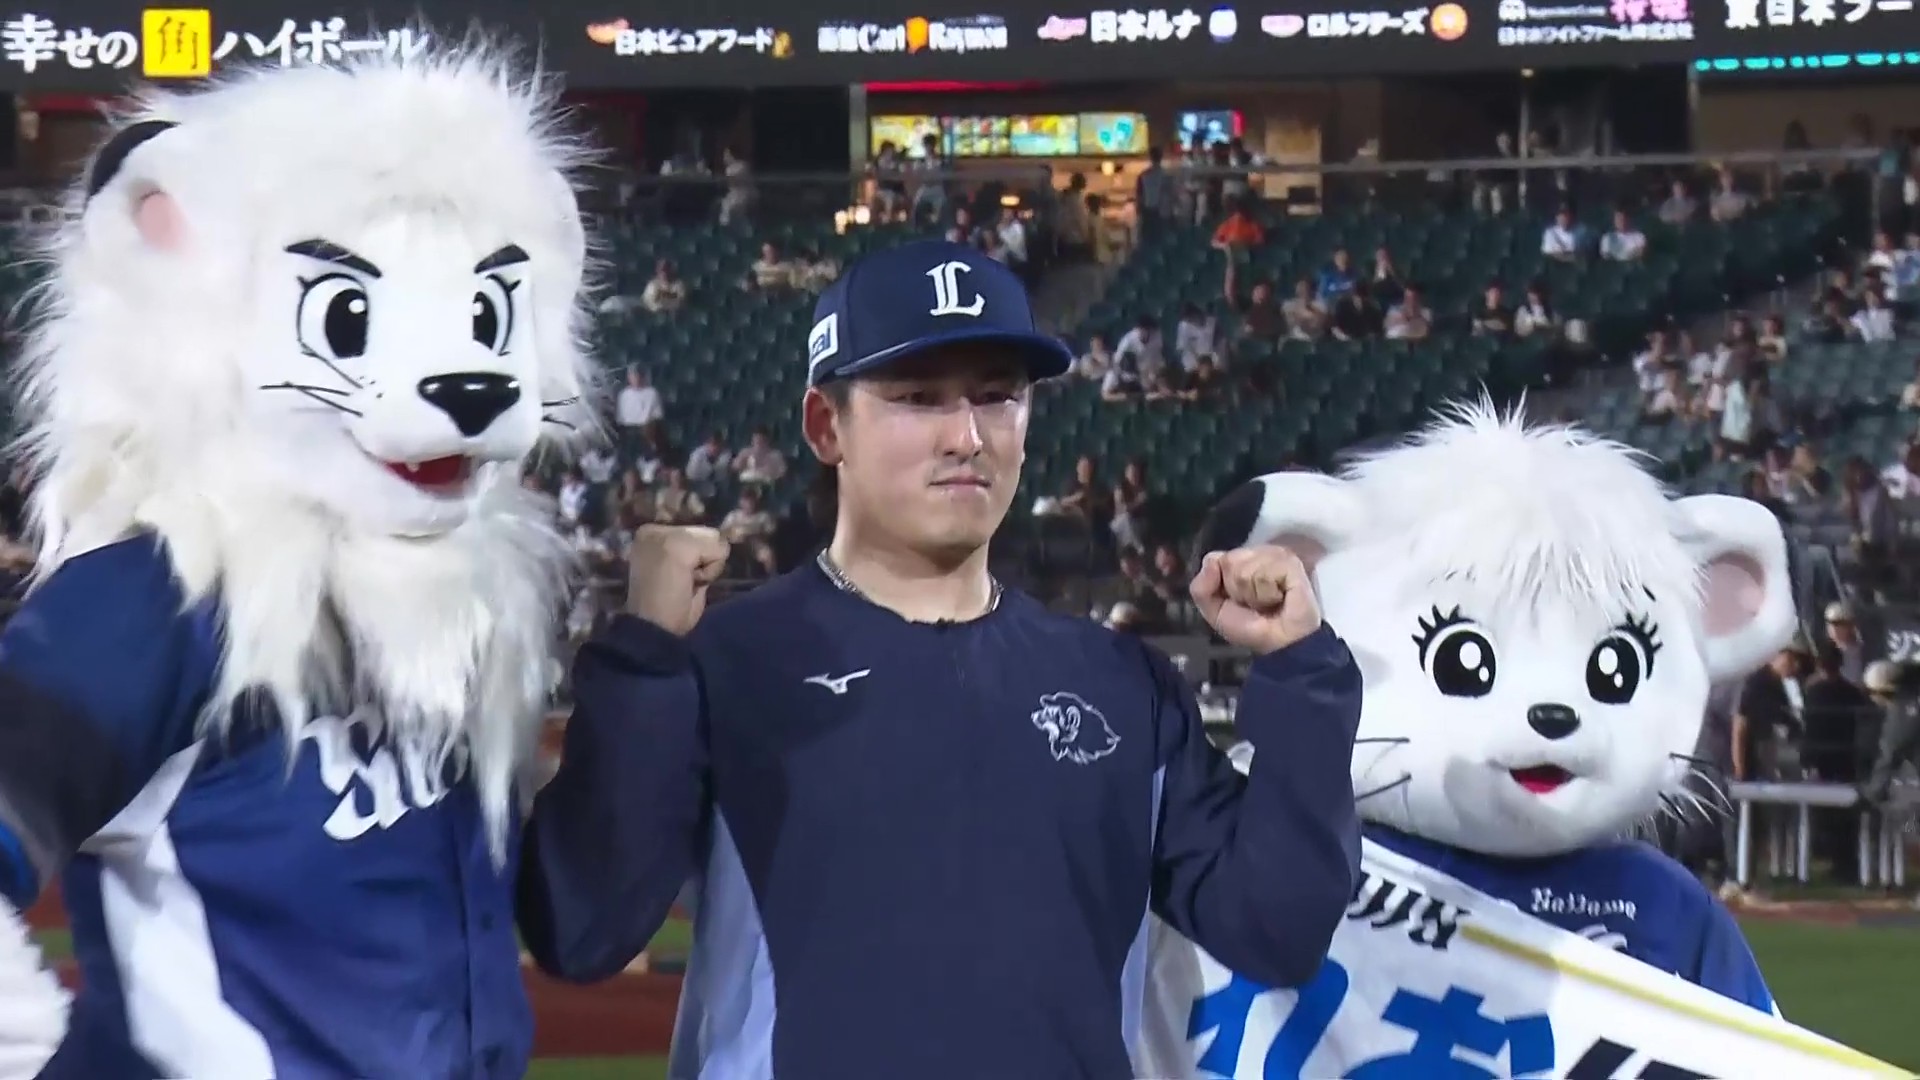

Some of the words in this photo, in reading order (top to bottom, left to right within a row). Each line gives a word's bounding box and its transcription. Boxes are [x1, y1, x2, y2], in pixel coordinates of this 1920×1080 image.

[1090, 8, 1201, 43] 日本ルナ
[925, 260, 986, 317] L
